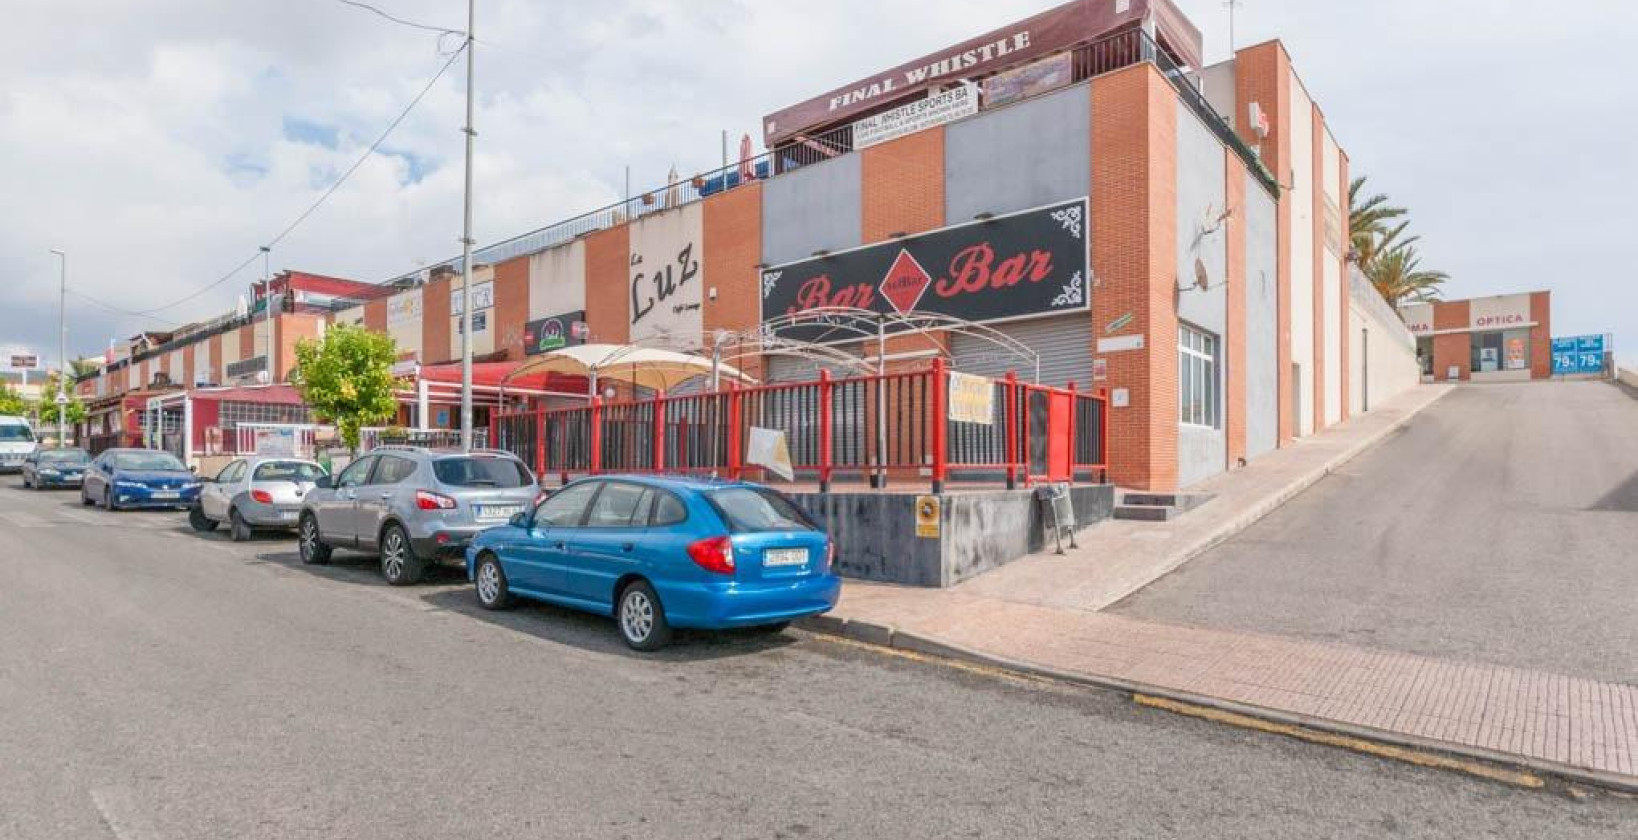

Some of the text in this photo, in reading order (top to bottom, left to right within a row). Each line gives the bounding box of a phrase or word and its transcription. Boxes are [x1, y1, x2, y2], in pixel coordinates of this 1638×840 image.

[829, 31, 1031, 111] FINAL WHISTLE
[855, 116, 878, 130] FINAL
[881, 104, 916, 124] WHISTLE
[918, 91, 954, 113] SPORTS
[936, 242, 1054, 297] Bar
[785, 274, 875, 317] Bar
[1477, 314, 1523, 326] OPTICA
